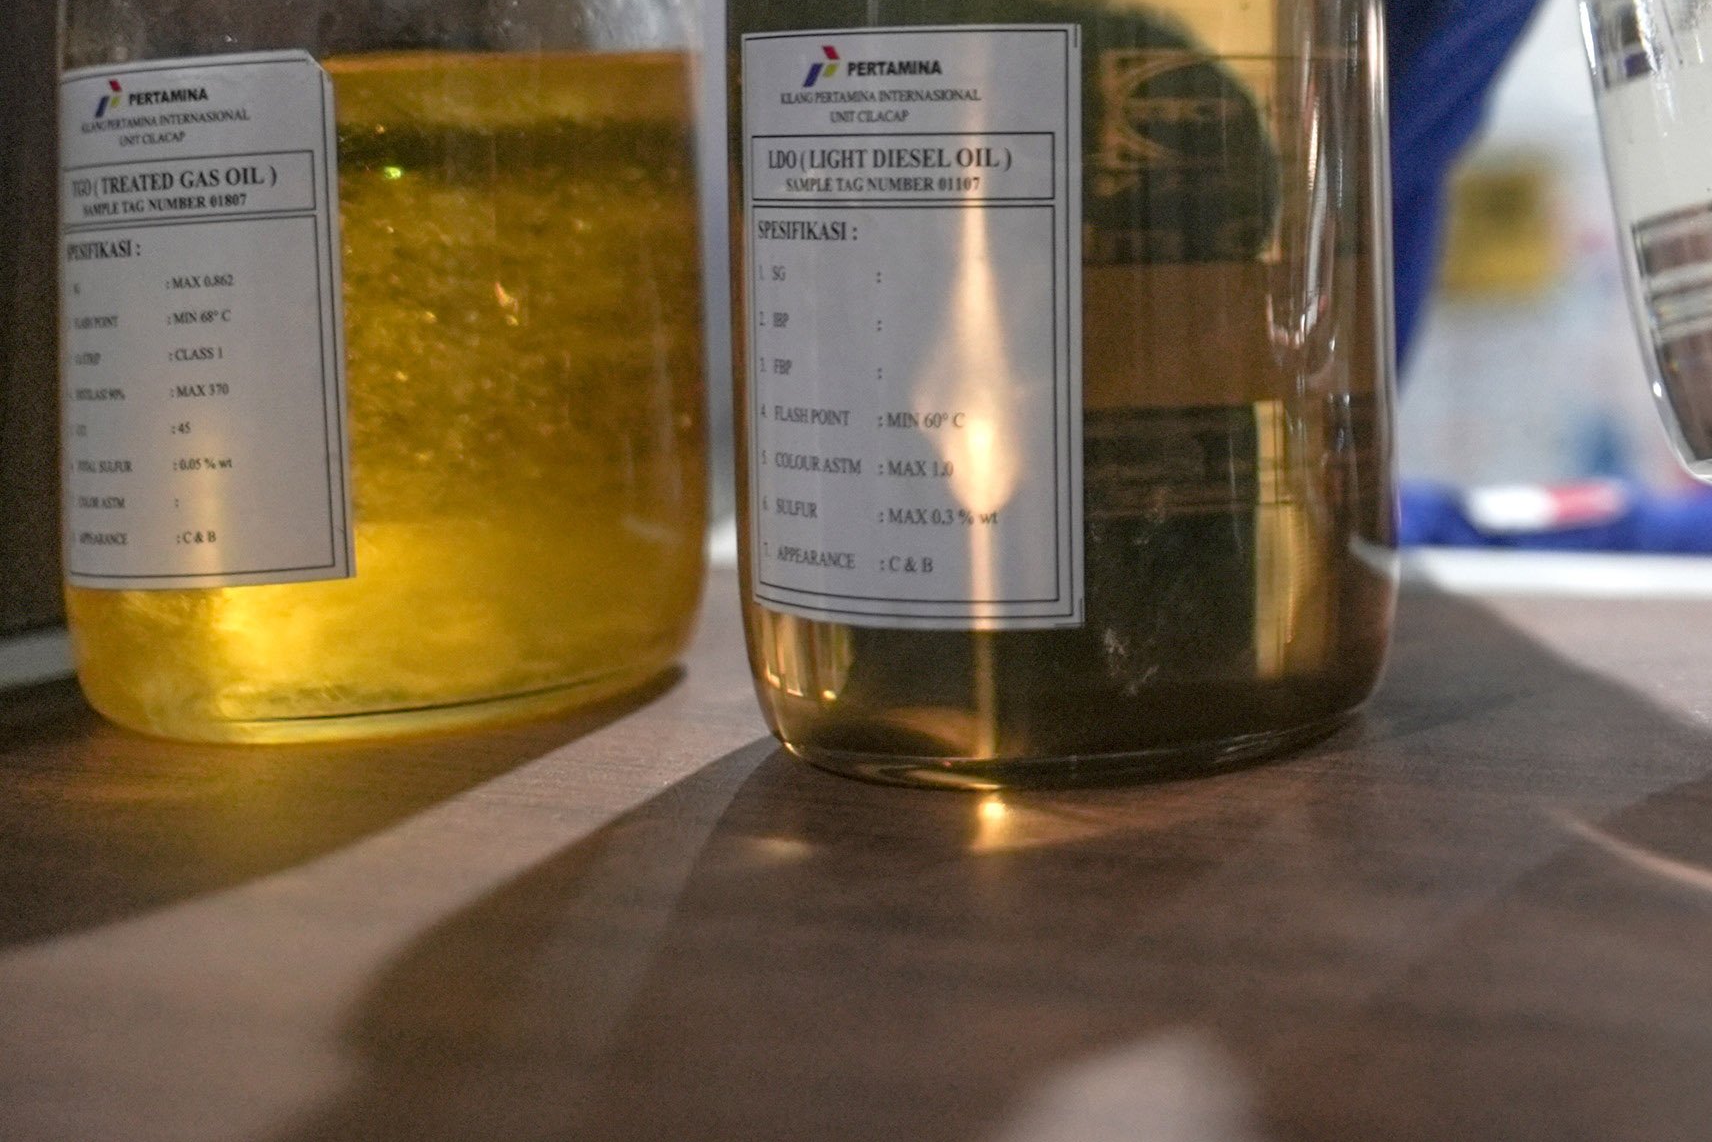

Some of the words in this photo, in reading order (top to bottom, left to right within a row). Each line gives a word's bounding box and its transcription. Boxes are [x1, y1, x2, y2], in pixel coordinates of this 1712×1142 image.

[848, 60, 943, 77] PERTAMINA
[129, 87, 208, 107] PERTAMINA
[814, 90, 876, 104] PERTAMINA
[878, 89, 982, 104] INTERNASIONAL
[107, 115, 157, 131] PERTAMINA
[159, 107, 250, 127] INTERNASIONAL
[830, 110, 857, 123] UNIT
[858, 109, 910, 123] CILACAP
[142, 131, 186, 145] CILACAP
[768, 149, 797, 169] LDO
[810, 148, 867, 169] LIGHT
[873, 148, 952, 169] DIESEL
[956, 147, 1001, 168] OIL
[101, 172, 174, 195] TREATED
[180, 169, 220, 188] GAS
[225, 166, 265, 186] OIL
[786, 177, 833, 193] SAMPLE
[836, 177, 864, 192] TAG
[866, 177, 934, 192] NUMBER
[938, 176, 980, 192] 01107
[83, 199, 119, 217] SAMPLE
[123, 198, 144, 214] TAG
[148, 195, 206, 213] NUMBER
[210, 192, 247, 209] 01807
[758, 221, 847, 241] SPESIFIKASI
[171, 275, 201, 290] MAX
[204, 273, 234, 288] 0.862
[772, 265, 786, 281] SG
[173, 311, 198, 325] MIN
[221, 309, 232, 323] C
[175, 348, 215, 362] CLASS
[176, 384, 206, 398] MAX
[775, 405, 809, 424] FLASH
[811, 408, 850, 426] POINT
[887, 411, 920, 428] MIN
[952, 412, 966, 428] C
[775, 452, 822, 471] COLOUR
[823, 457, 862, 474] ASTM
[888, 460, 926, 476] MAX
[932, 460, 954, 477] 1.0
[776, 498, 818, 518] SULFUR
[888, 508, 928, 525] MAX
[931, 508, 954, 525] 0.3
[958, 508, 974, 525] %
[979, 511, 999, 525] wt
[777, 546, 856, 570] APPEARANCE
[889, 555, 901, 572] C
[904, 556, 917, 573] &
[921, 556, 934, 573] B
